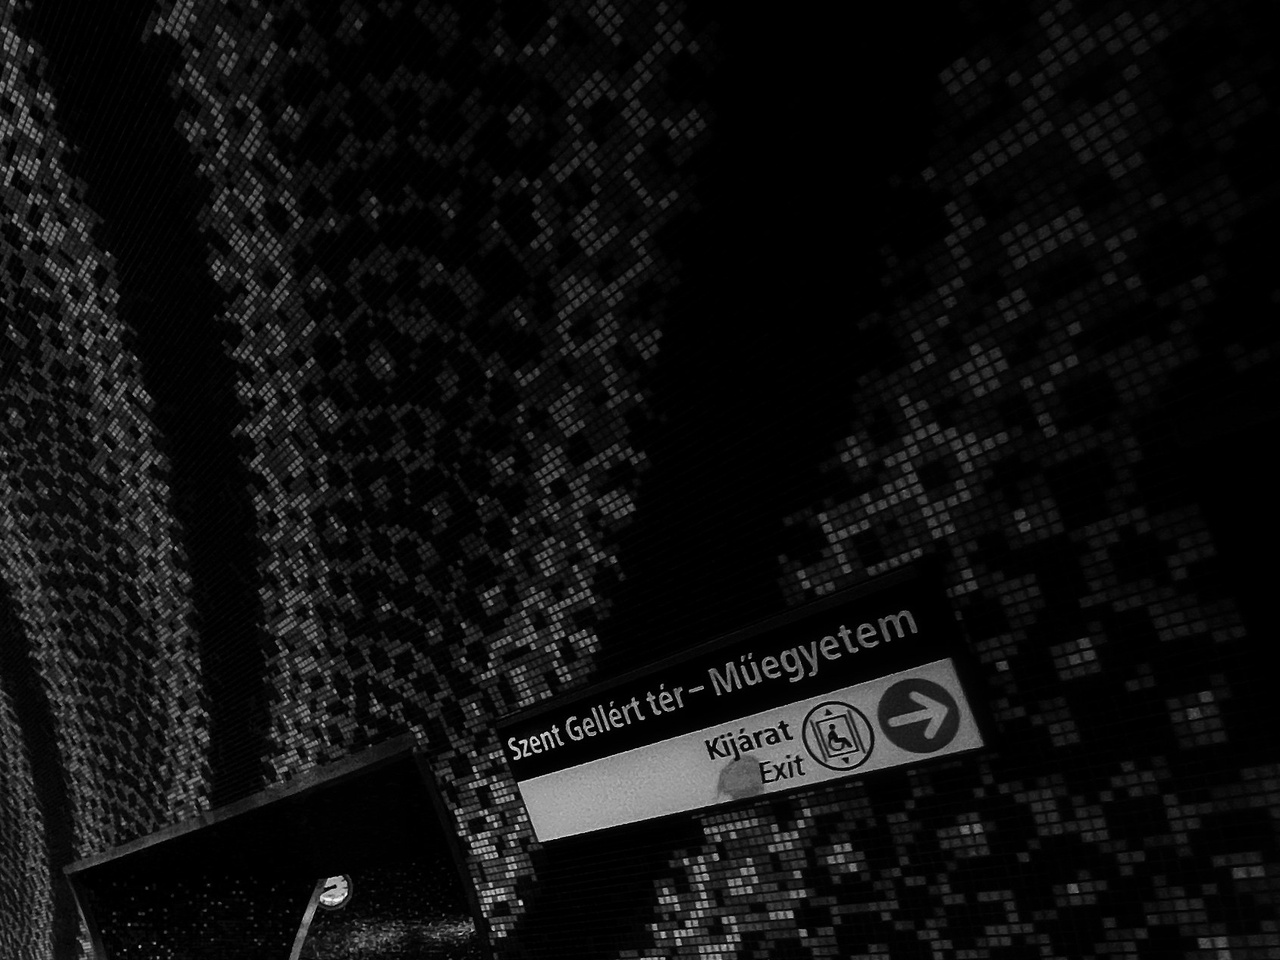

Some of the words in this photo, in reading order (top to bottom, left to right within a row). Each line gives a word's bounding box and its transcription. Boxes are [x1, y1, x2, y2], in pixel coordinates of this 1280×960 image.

[507, 724, 565, 762] Szent
[564, 704, 646, 744] Gellért
[645, 683, 685, 720] tér
[707, 607, 919, 698] Műegyetem
[704, 720, 794, 761] Kijárat
[759, 754, 806, 784] Exit
